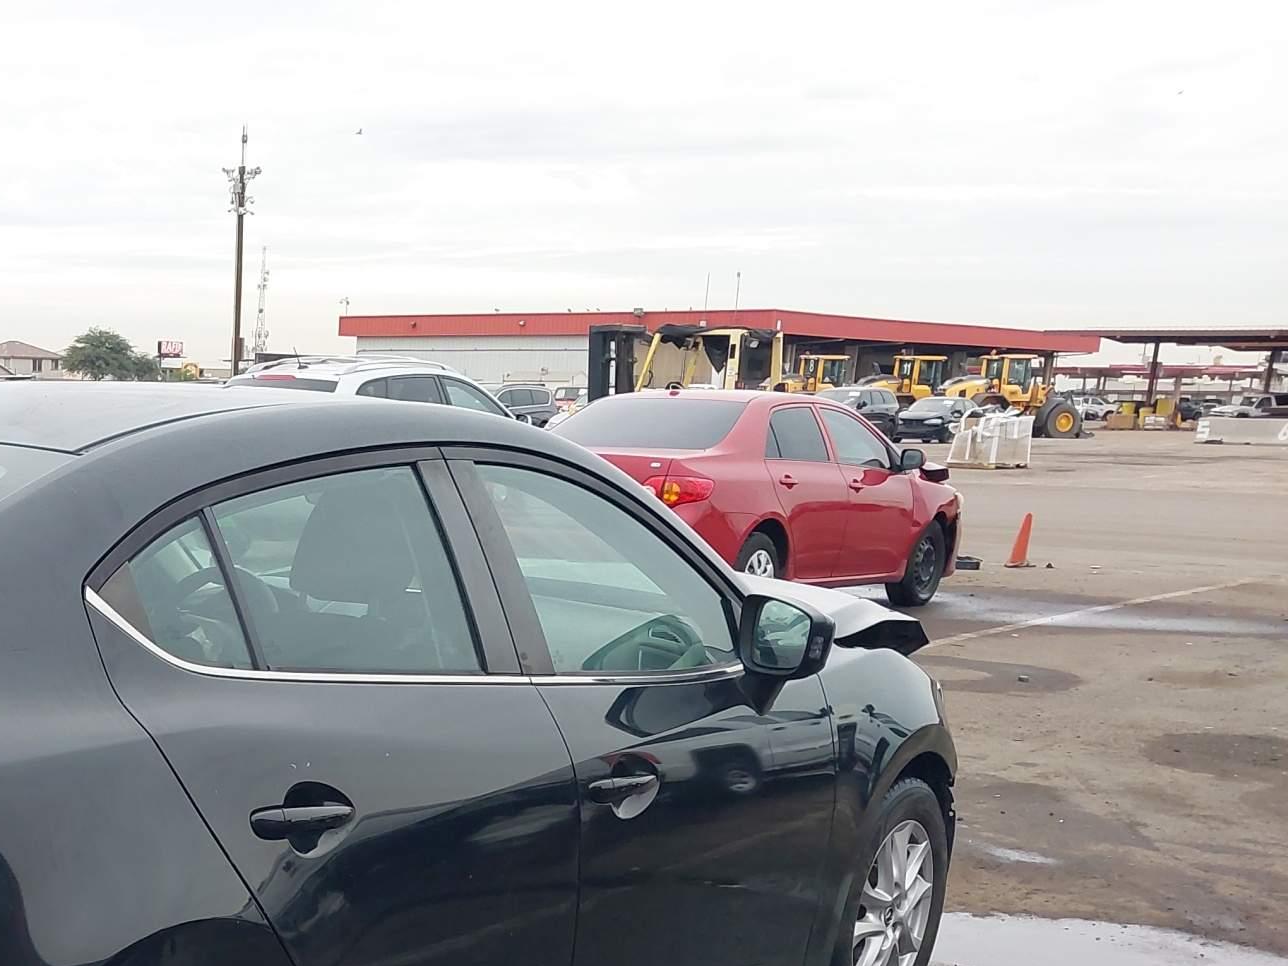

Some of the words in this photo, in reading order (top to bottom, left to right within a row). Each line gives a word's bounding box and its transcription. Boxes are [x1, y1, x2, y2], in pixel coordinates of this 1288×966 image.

[809, 360, 815, 372] 8
[903, 361, 912, 376] 11
[1196, 420, 1210, 439] 5
